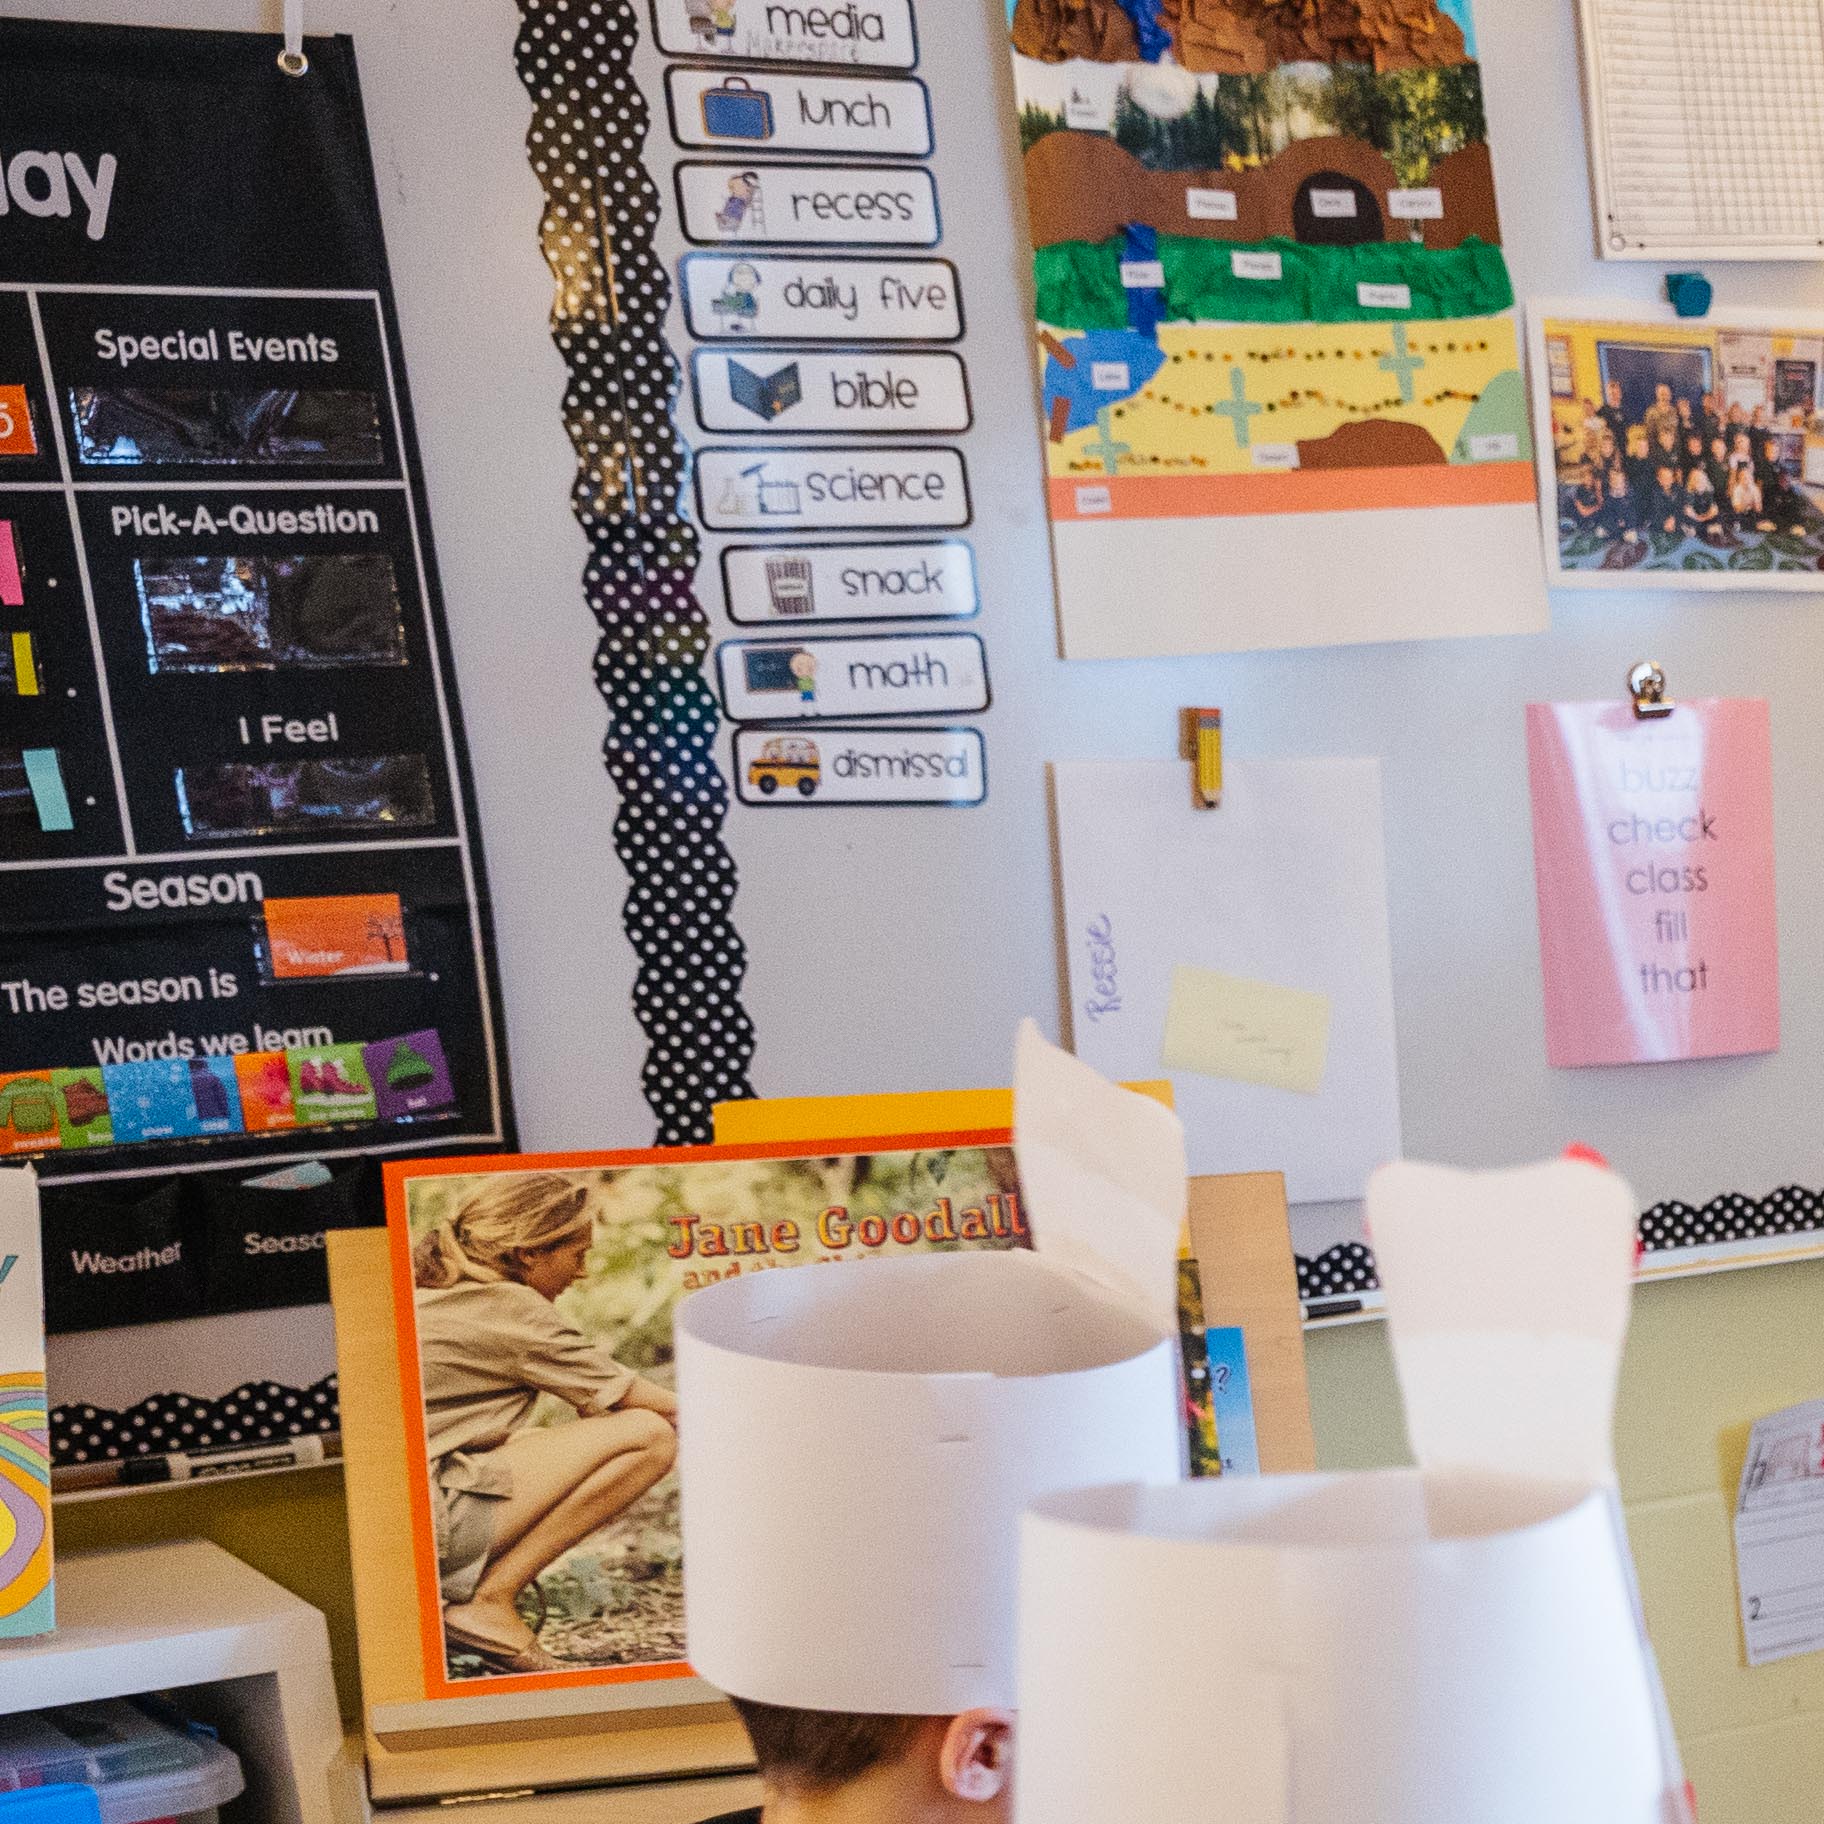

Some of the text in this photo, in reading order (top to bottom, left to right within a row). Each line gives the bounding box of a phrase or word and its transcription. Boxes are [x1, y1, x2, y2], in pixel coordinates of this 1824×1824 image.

[767, 3, 884, 41] media
[799, 92, 892, 131] lunch
[0, 147, 118, 240] ay
[791, 190, 915, 224] recess
[784, 272, 947, 323] daily five
[95, 328, 339, 367] Special Events
[833, 370, 920, 411] bible
[807, 466, 947, 501] science
[111, 505, 379, 539] Pick-A-Question
[843, 558, 946, 598] snack
[848, 655, 948, 691] math
[239, 713, 339, 745] I Feel
[833, 747, 968, 779] dismissal
[1621, 759, 1698, 792] buzz
[1607, 806, 1718, 845] check
[103, 870, 263, 911] Season
[1625, 860, 1709, 895] class
[1655, 909, 1687, 943] fill
[287, 946, 343, 968] Winter
[2, 970, 239, 1014] The season is
[1640, 959, 1709, 993] that
[92, 1023, 334, 1066] Words we learn
[668, 1190, 1027, 1260] Jane Goodall
[71, 1241, 183, 1275] Weather
